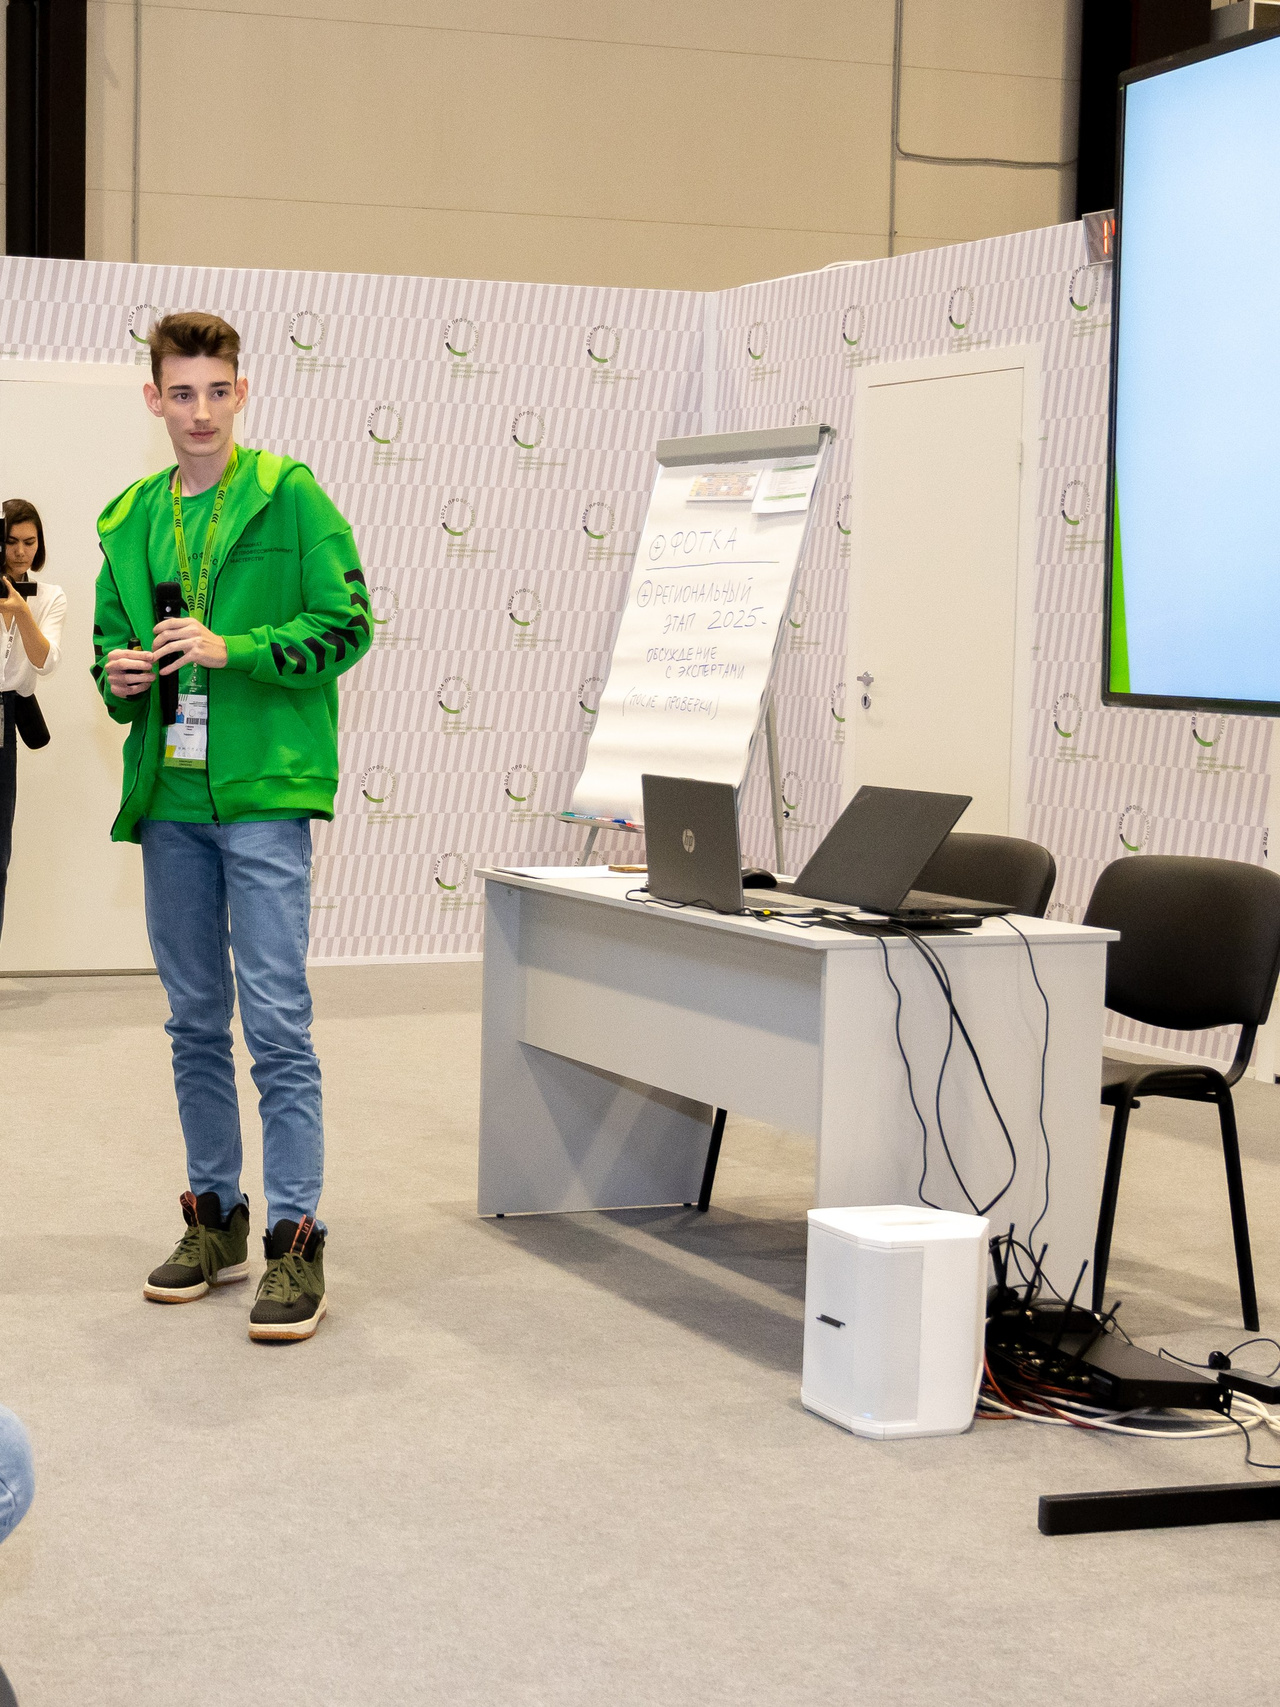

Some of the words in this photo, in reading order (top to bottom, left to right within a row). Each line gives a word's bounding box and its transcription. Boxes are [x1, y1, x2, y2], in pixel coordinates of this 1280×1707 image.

[671, 527, 738, 556] ФОТКА
[653, 577, 753, 606] РЕГИОНАЛЬНЫЙ
[664, 613, 696, 634] ЭТАП
[647, 646, 718, 662] ОБСУЖДЕНИЕ
[666, 666, 672, 678] С
[678, 664, 745, 679] ЭКСПЕРТАМИ
